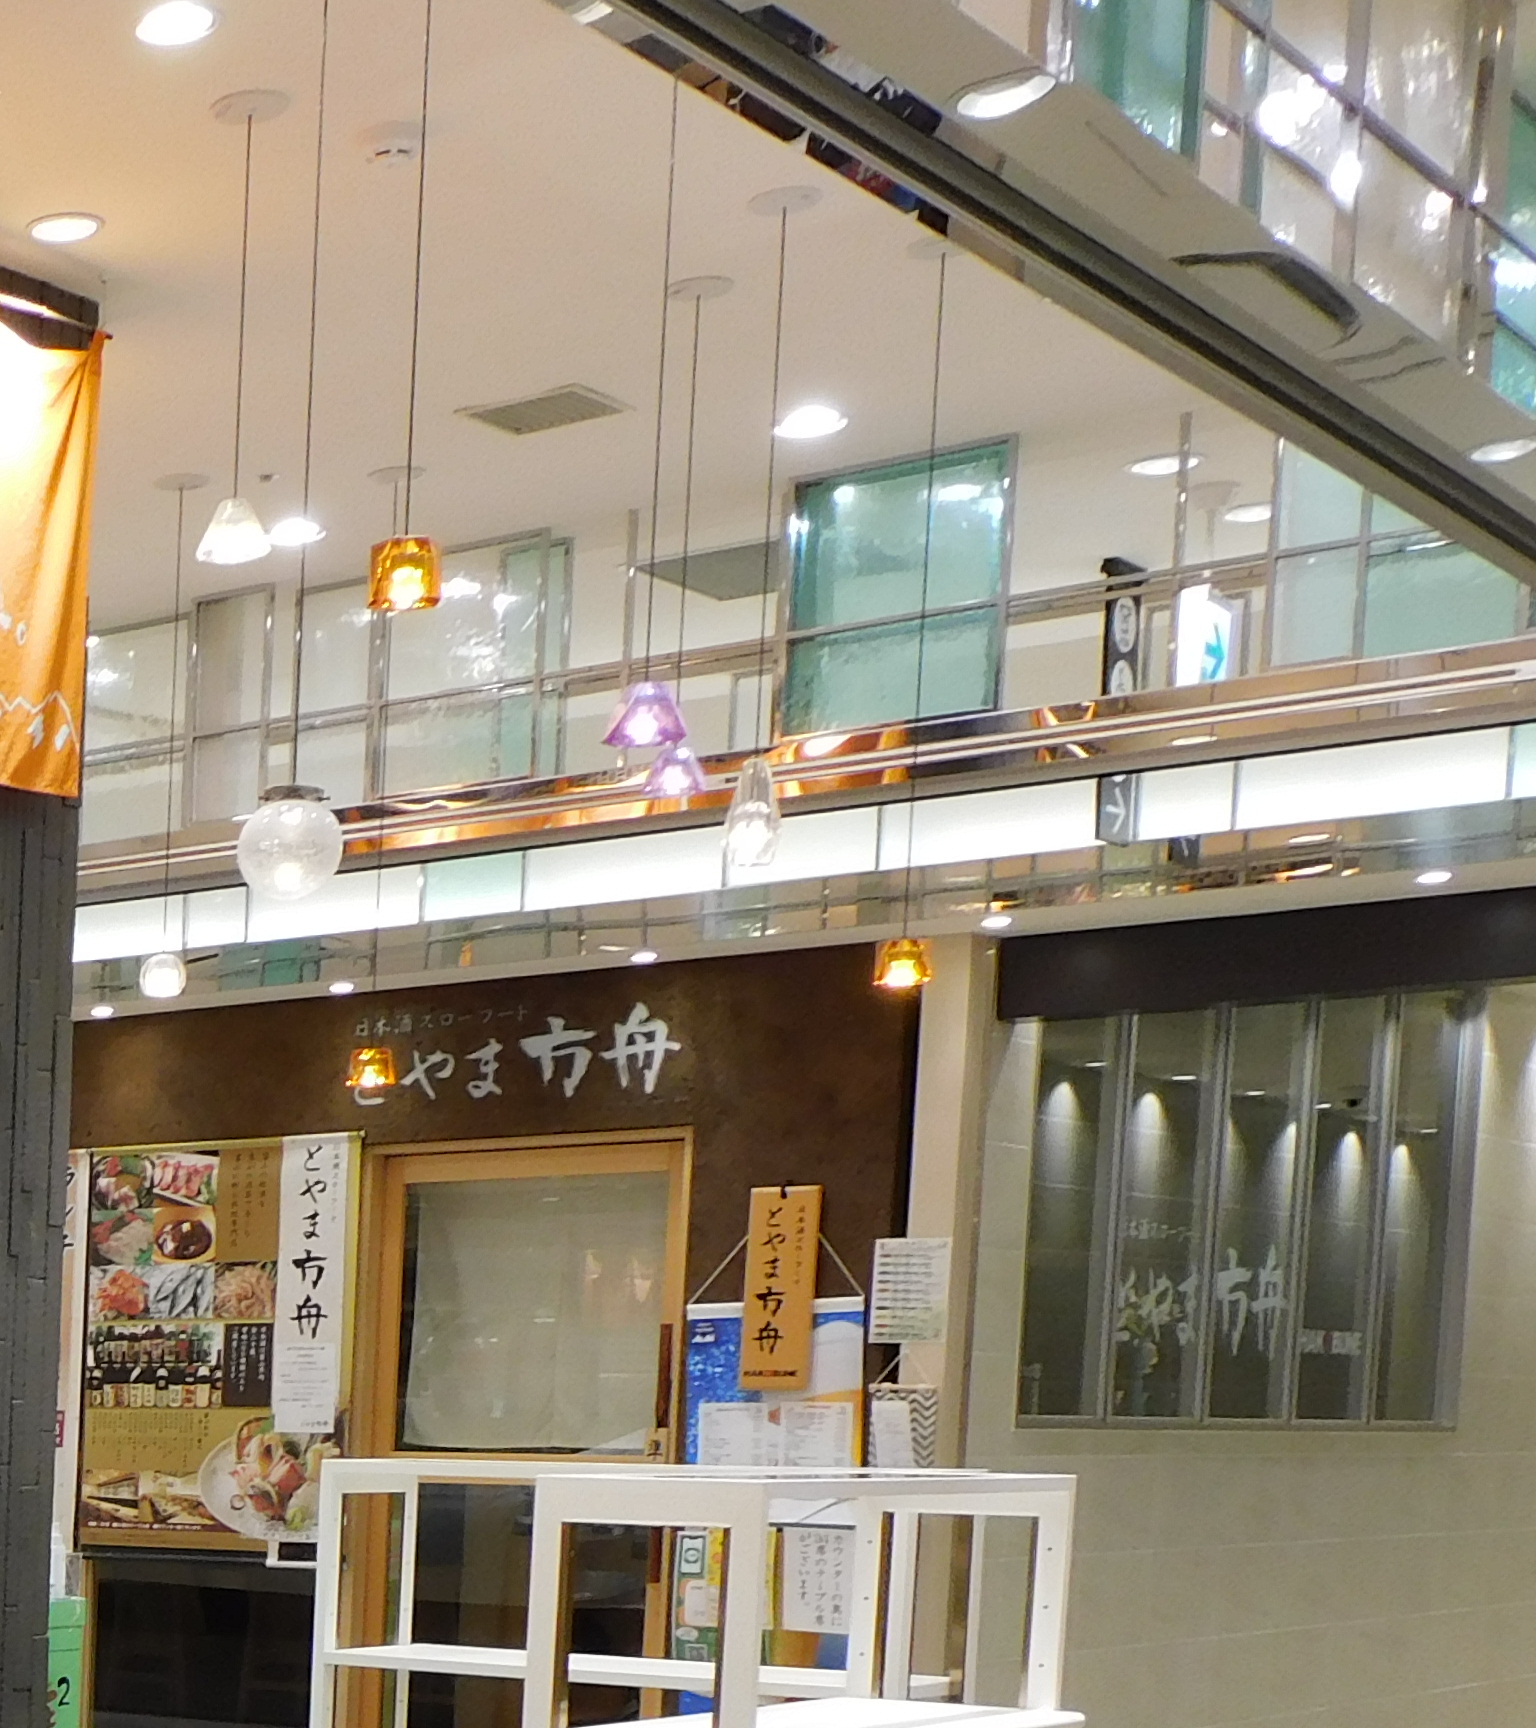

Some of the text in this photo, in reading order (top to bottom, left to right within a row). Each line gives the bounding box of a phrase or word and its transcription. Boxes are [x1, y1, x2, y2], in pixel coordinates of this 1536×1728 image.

[353, 1001, 682, 1106] やま方舟
[289, 1145, 328, 1340] とやま方舟
[751, 1206, 786, 1356] とやま方舟
[57, 1676, 70, 1707] 2
